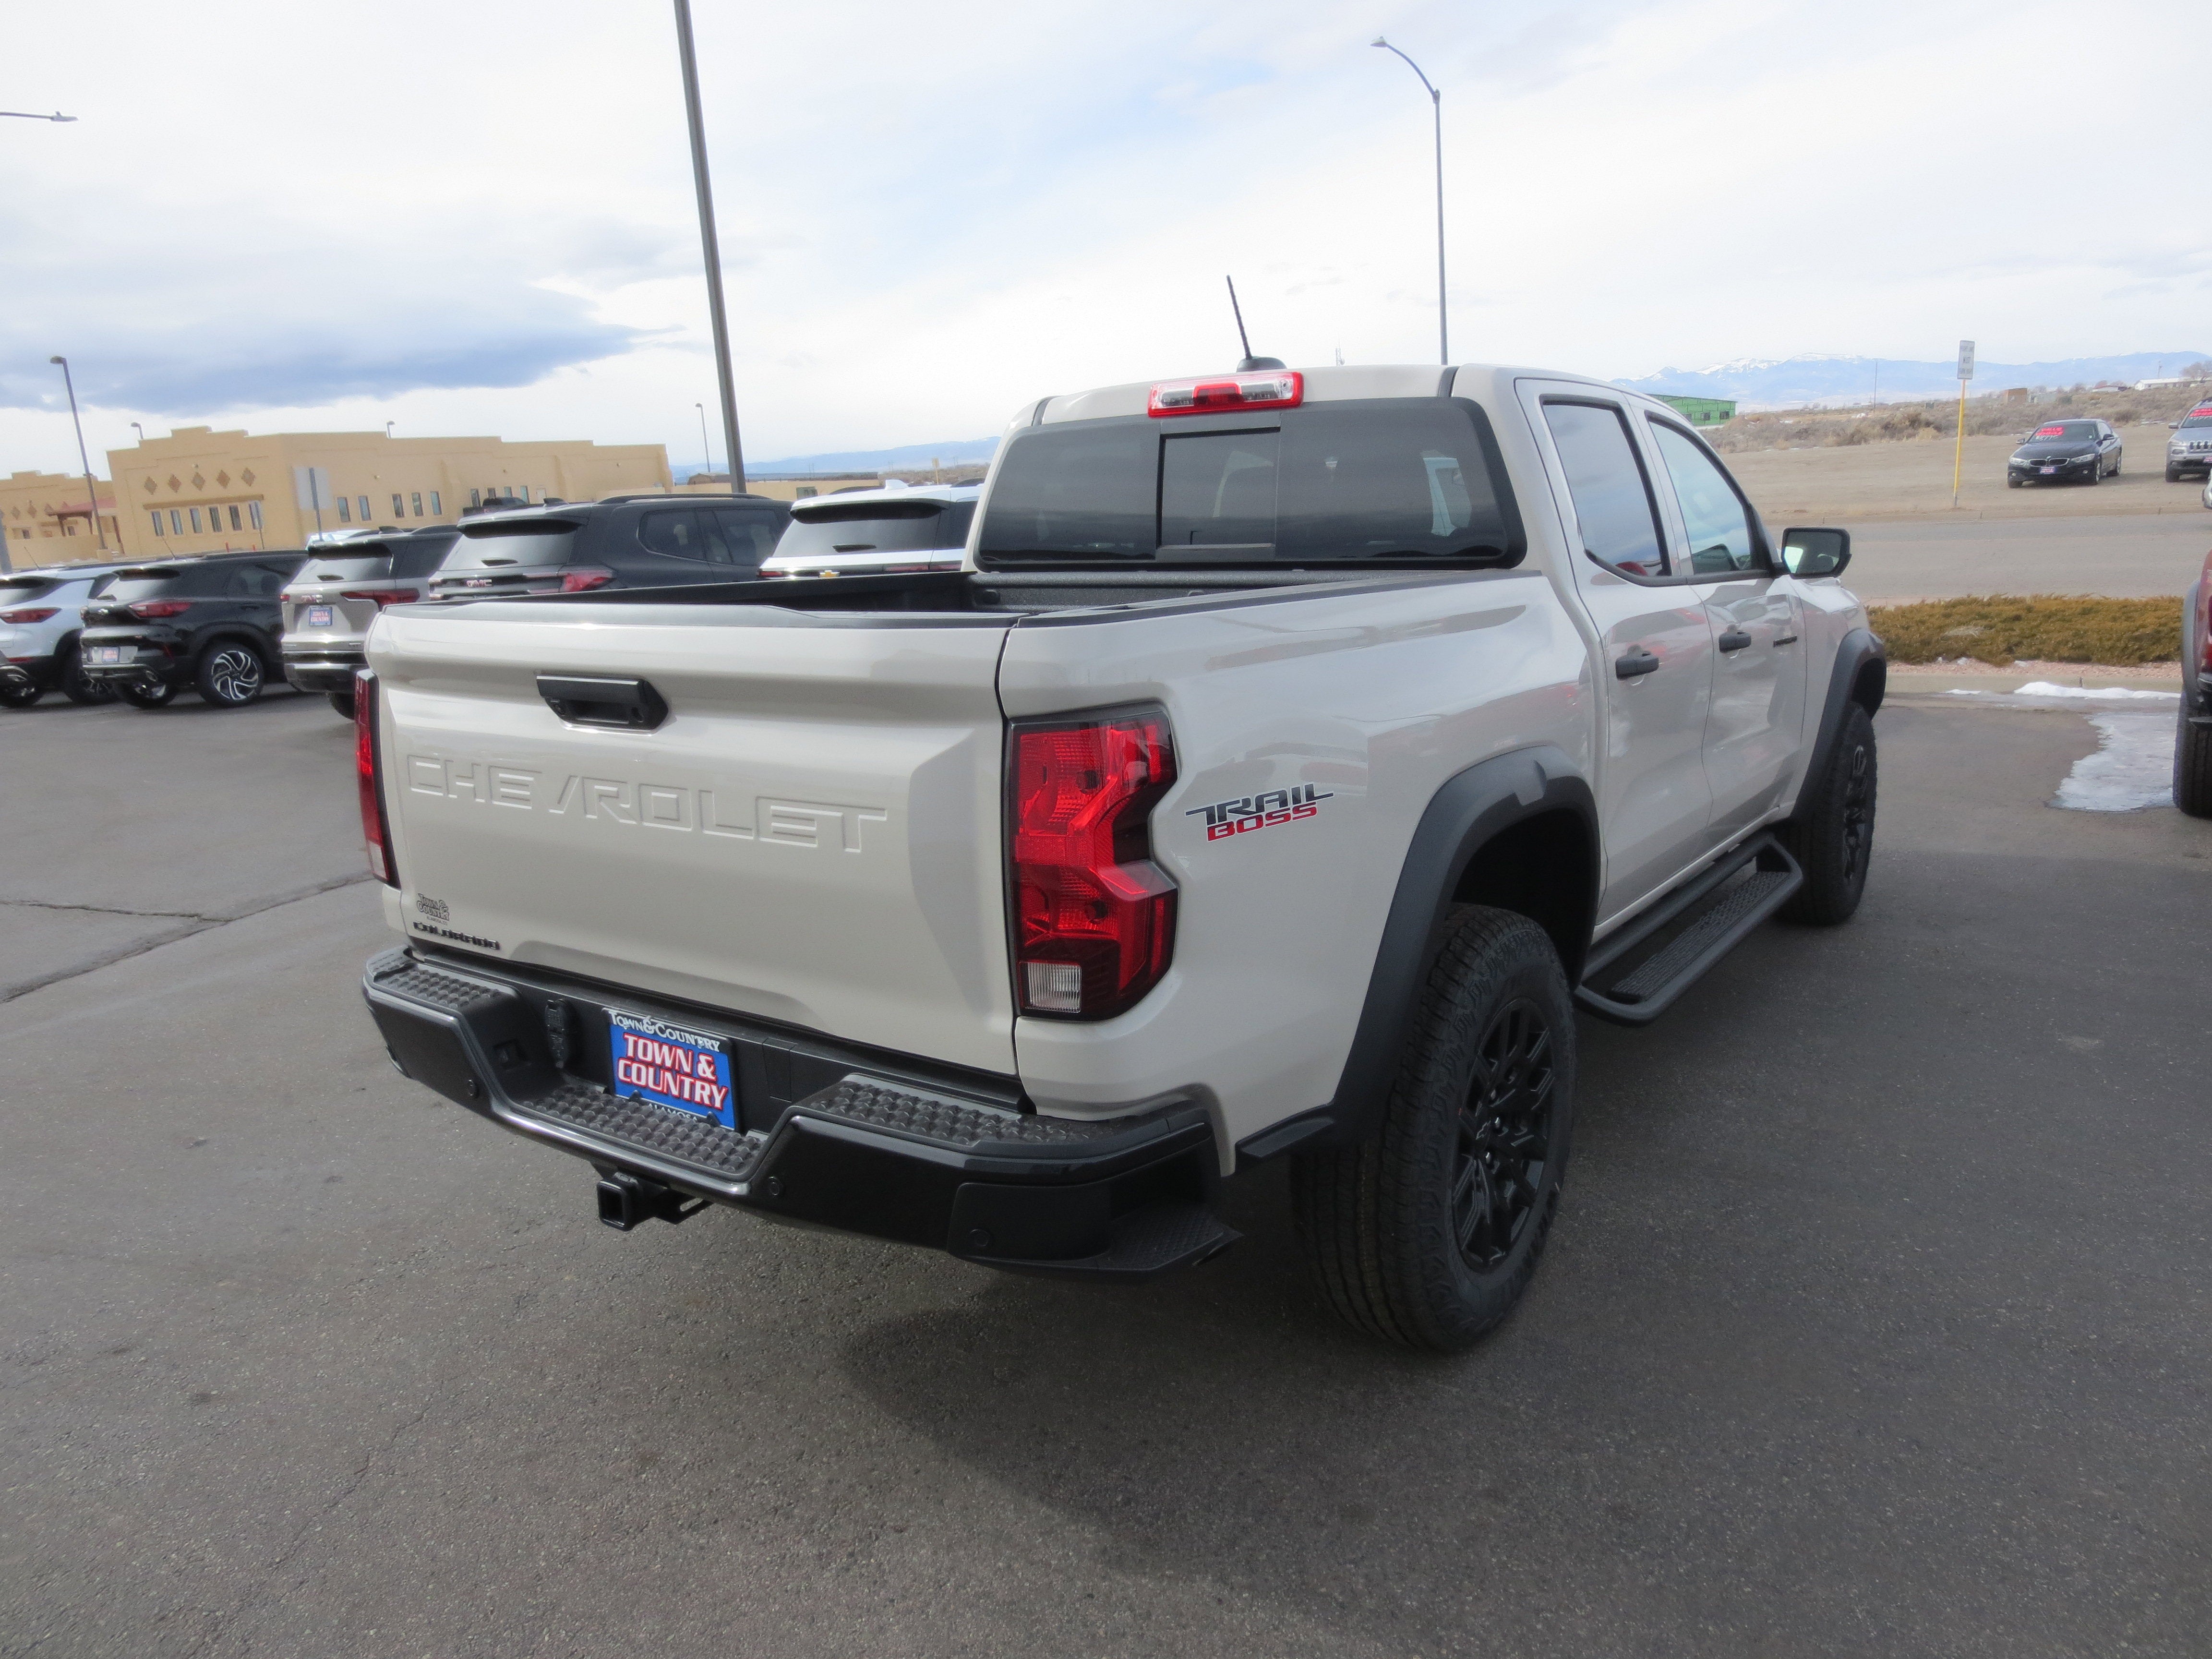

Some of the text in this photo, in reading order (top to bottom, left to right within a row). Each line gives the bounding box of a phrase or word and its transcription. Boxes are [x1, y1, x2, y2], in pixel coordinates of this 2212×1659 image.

[466, 579, 493, 587] GMC
[408, 755, 887, 853] CHEVROLET
[1185, 782, 1334, 826] TRAIL
[1207, 802, 1318, 842] BOSS
[413, 921, 501, 950] COLORADO
[623, 1032, 718, 1082] TOWN &
[617, 1057, 729, 1111] COUNTRY
